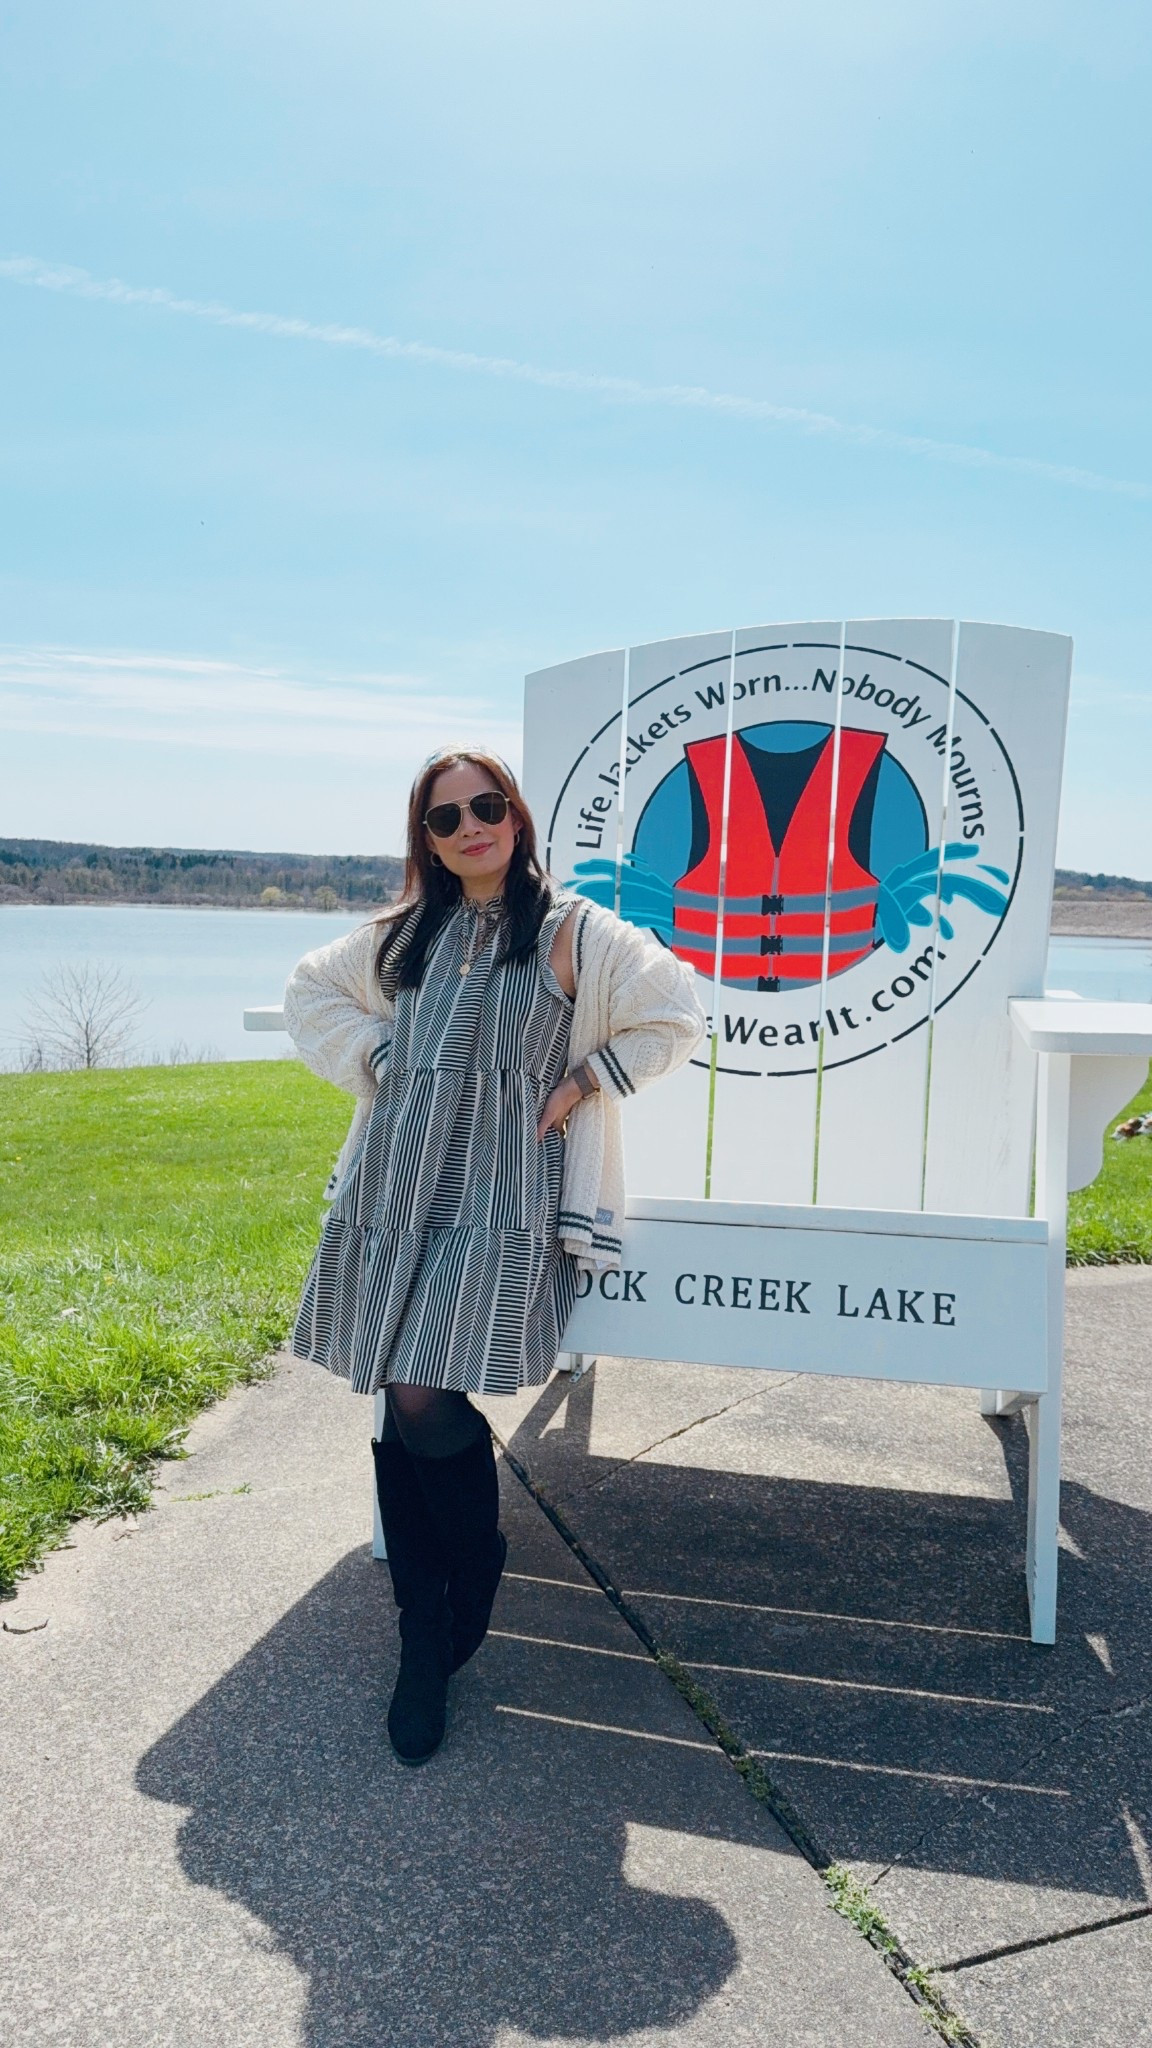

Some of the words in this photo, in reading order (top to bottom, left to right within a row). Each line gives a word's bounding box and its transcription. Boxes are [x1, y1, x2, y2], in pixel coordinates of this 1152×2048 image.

[575, 796, 612, 849] Life
[598, 703, 692, 796] Jackets
[926, 723, 985, 839] Mourns
[576, 1269, 648, 1303] OCK
[674, 1273, 812, 1315] CREEK
[837, 1284, 957, 1327] LAKE
